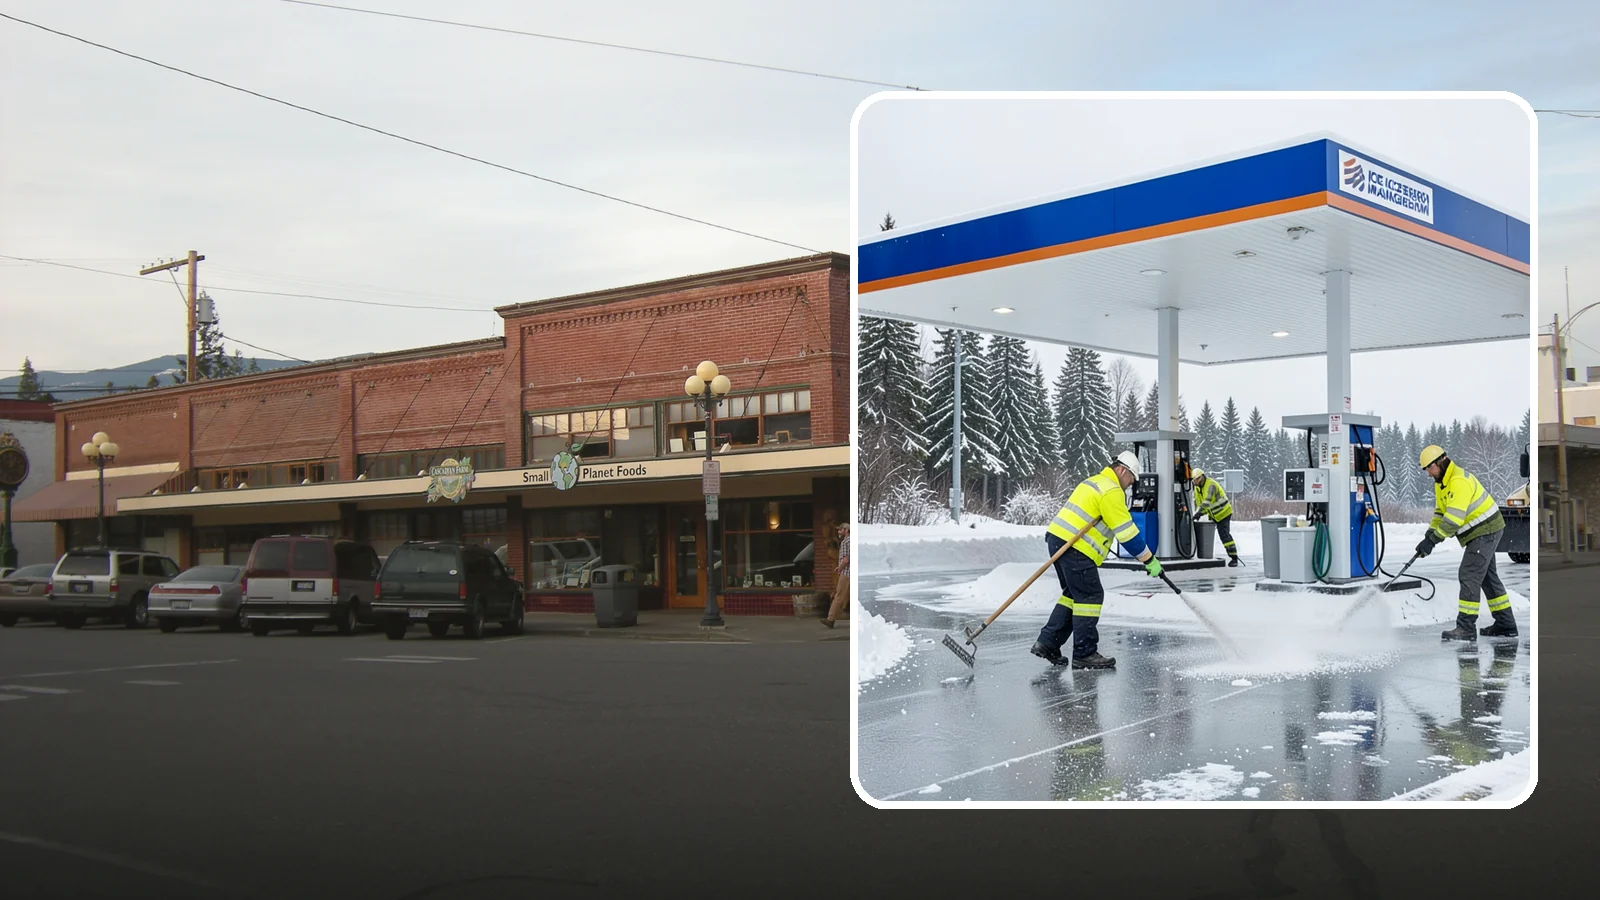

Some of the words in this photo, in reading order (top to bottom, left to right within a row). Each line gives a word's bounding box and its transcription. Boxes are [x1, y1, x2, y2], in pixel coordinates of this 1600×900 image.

[523, 471, 549, 483] Small
[582, 467, 614, 479] Planet
[616, 464, 647, 477] Foods
